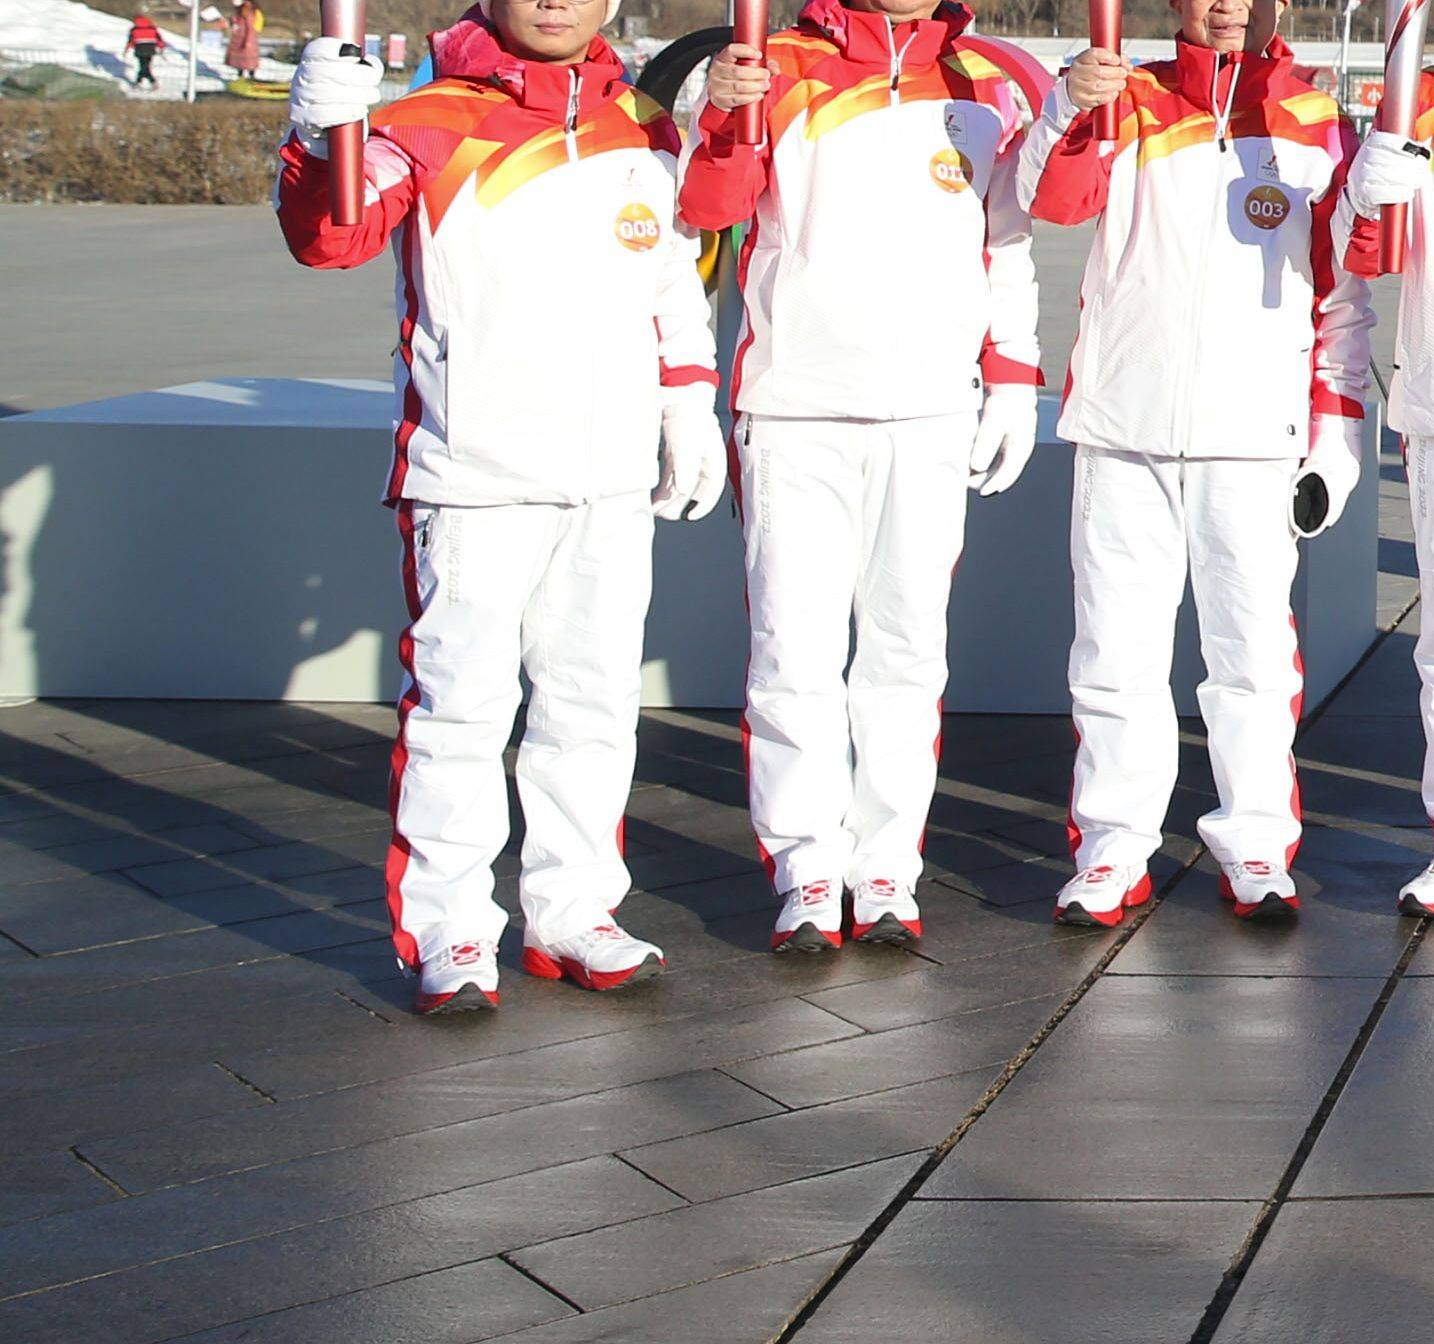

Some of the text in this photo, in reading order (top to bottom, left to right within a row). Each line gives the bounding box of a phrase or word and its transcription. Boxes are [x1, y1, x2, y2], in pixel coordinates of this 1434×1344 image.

[1249, 200, 1284, 217] 003
[620, 219, 657, 239] 008
[759, 448, 771, 496] BEIJING
[446, 513, 463, 565] BEIJING
